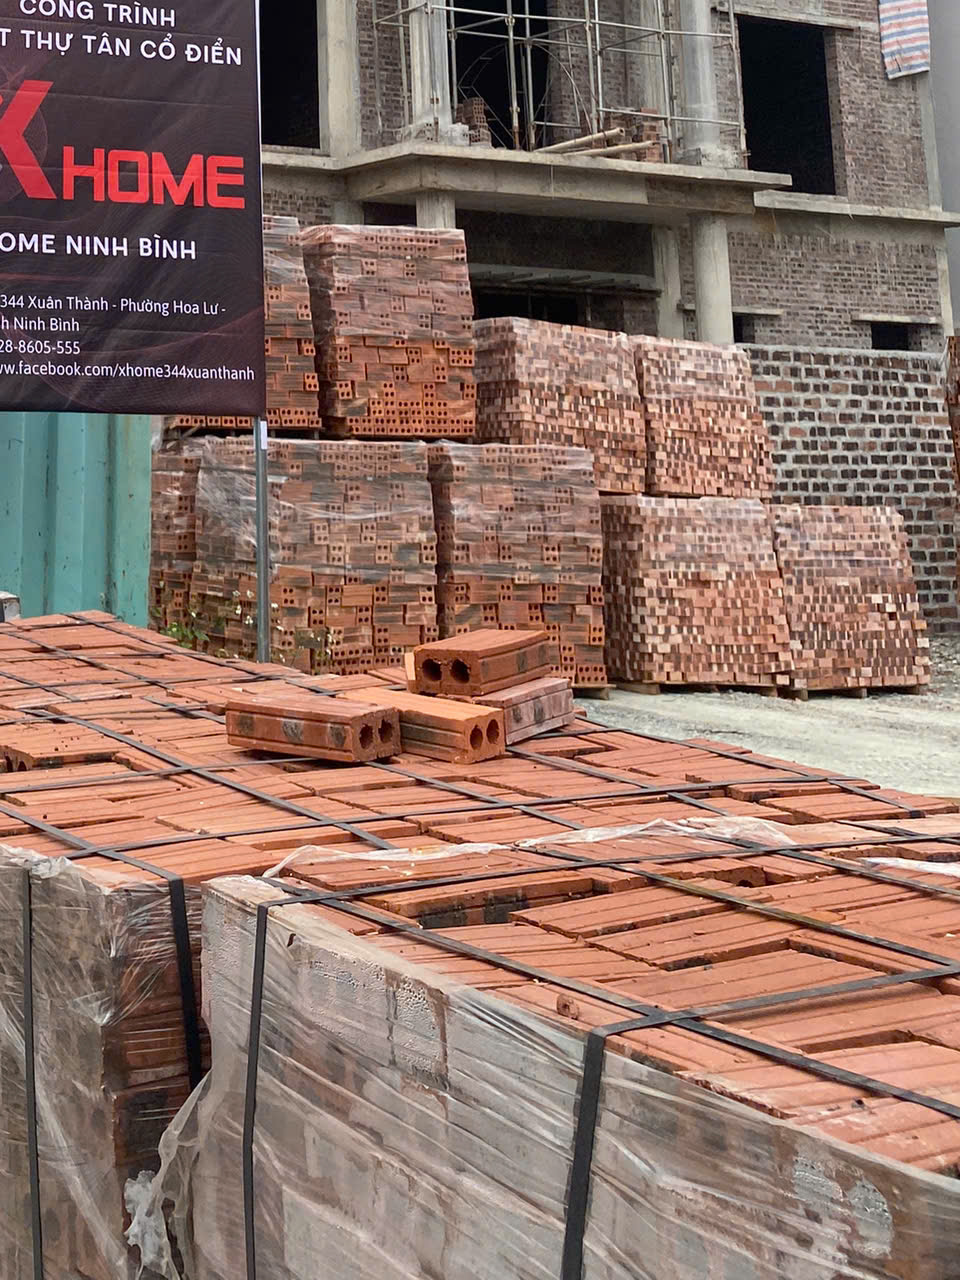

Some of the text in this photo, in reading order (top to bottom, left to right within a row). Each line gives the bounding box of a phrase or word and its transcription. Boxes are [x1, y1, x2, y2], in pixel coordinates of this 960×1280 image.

[103, 1, 176, 28] TRÌNH
[20, 29, 74, 56] THỰ
[82, 32, 131, 57] TÂN
[140, 33, 176, 61] CỔ
[185, 38, 242, 66] ĐIỂN
[66, 235, 129, 258] NINH
[139, 234, 197, 260] BÌNH
[0, 294, 25, 308] 344
[27, 295, 63, 310] Xuân
[66, 296, 109, 311] Thành
[120, 298, 170, 317] Phường
[173, 300, 200, 314] Hoa
[203, 301, 219, 315] Lư
[13, 316, 46, 331] Ninh
[50, 317, 80, 332] Bình
